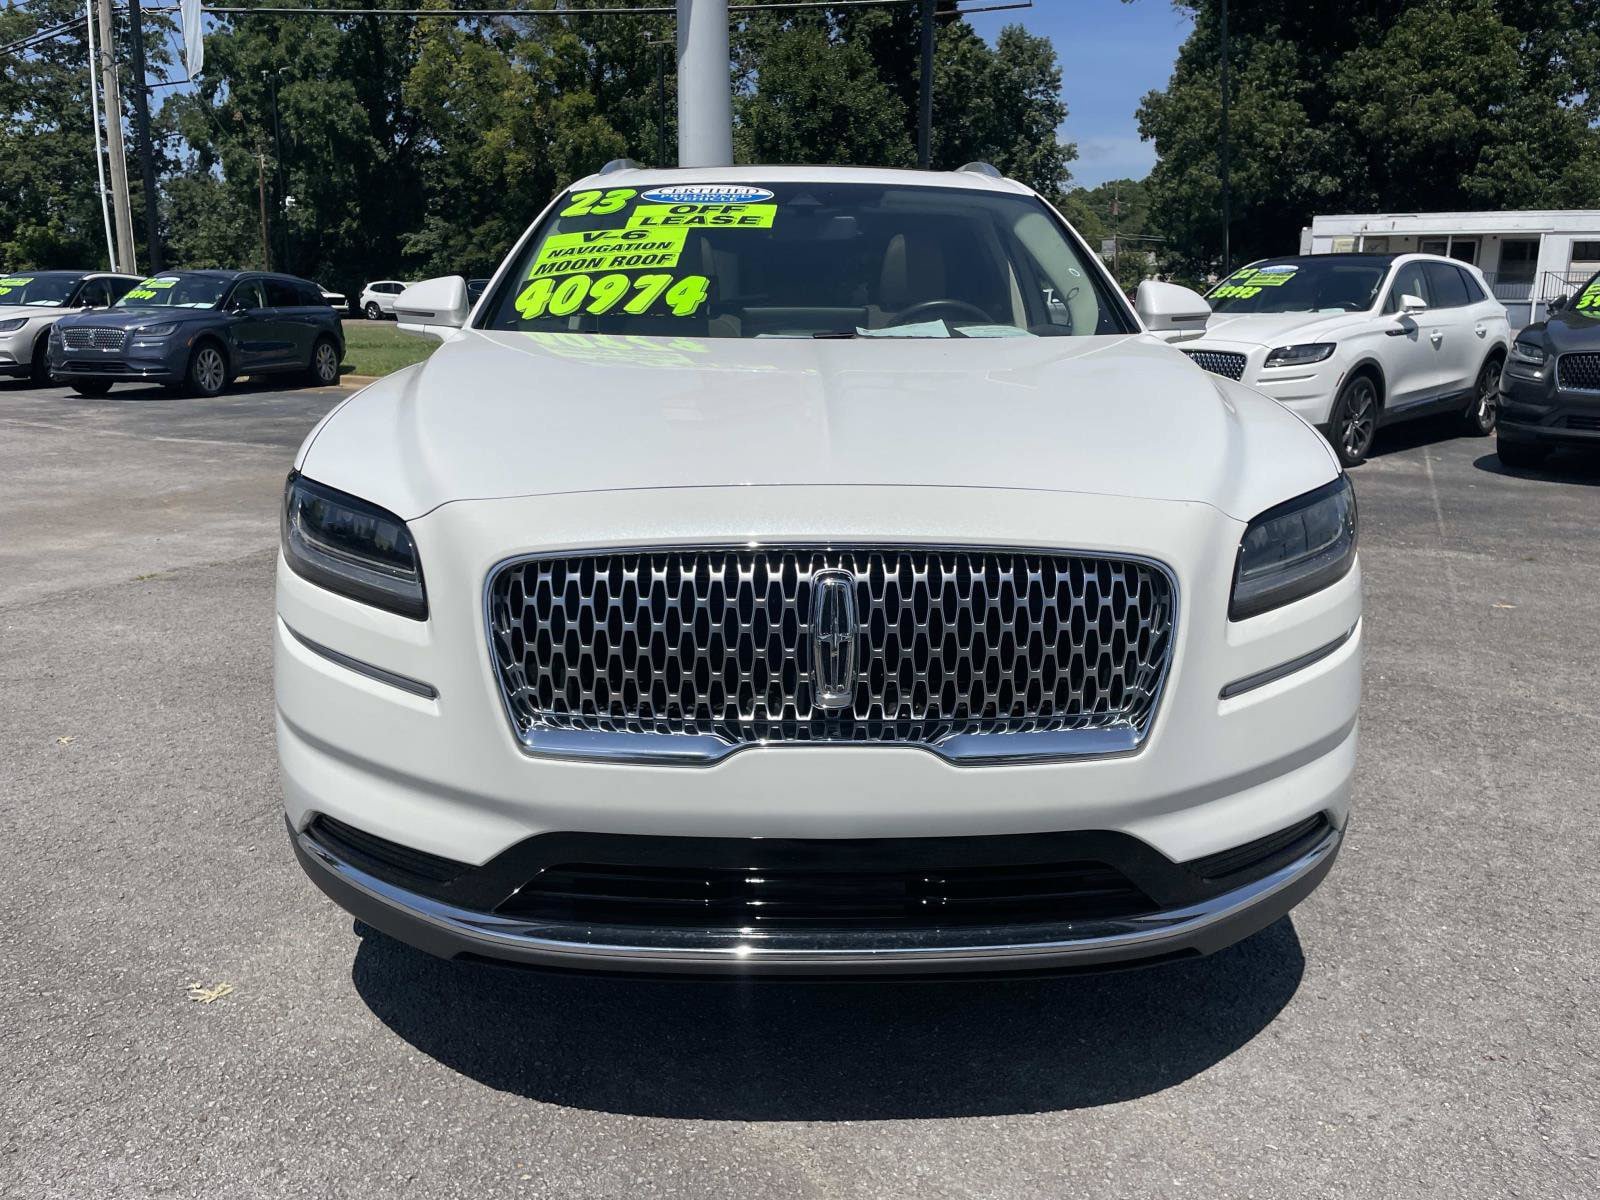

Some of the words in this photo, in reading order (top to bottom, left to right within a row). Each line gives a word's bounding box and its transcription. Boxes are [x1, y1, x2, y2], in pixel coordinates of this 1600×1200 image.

[560, 189, 637, 217] 23
[669, 205, 748, 214] OFF
[639, 216, 761, 226] LEASE
[583, 230, 649, 243] V-6
[548, 242, 673, 258] NAVIGATION
[535, 257, 602, 275] MOON
[612, 254, 675, 267] ROOF
[515, 274, 710, 320] 40974
